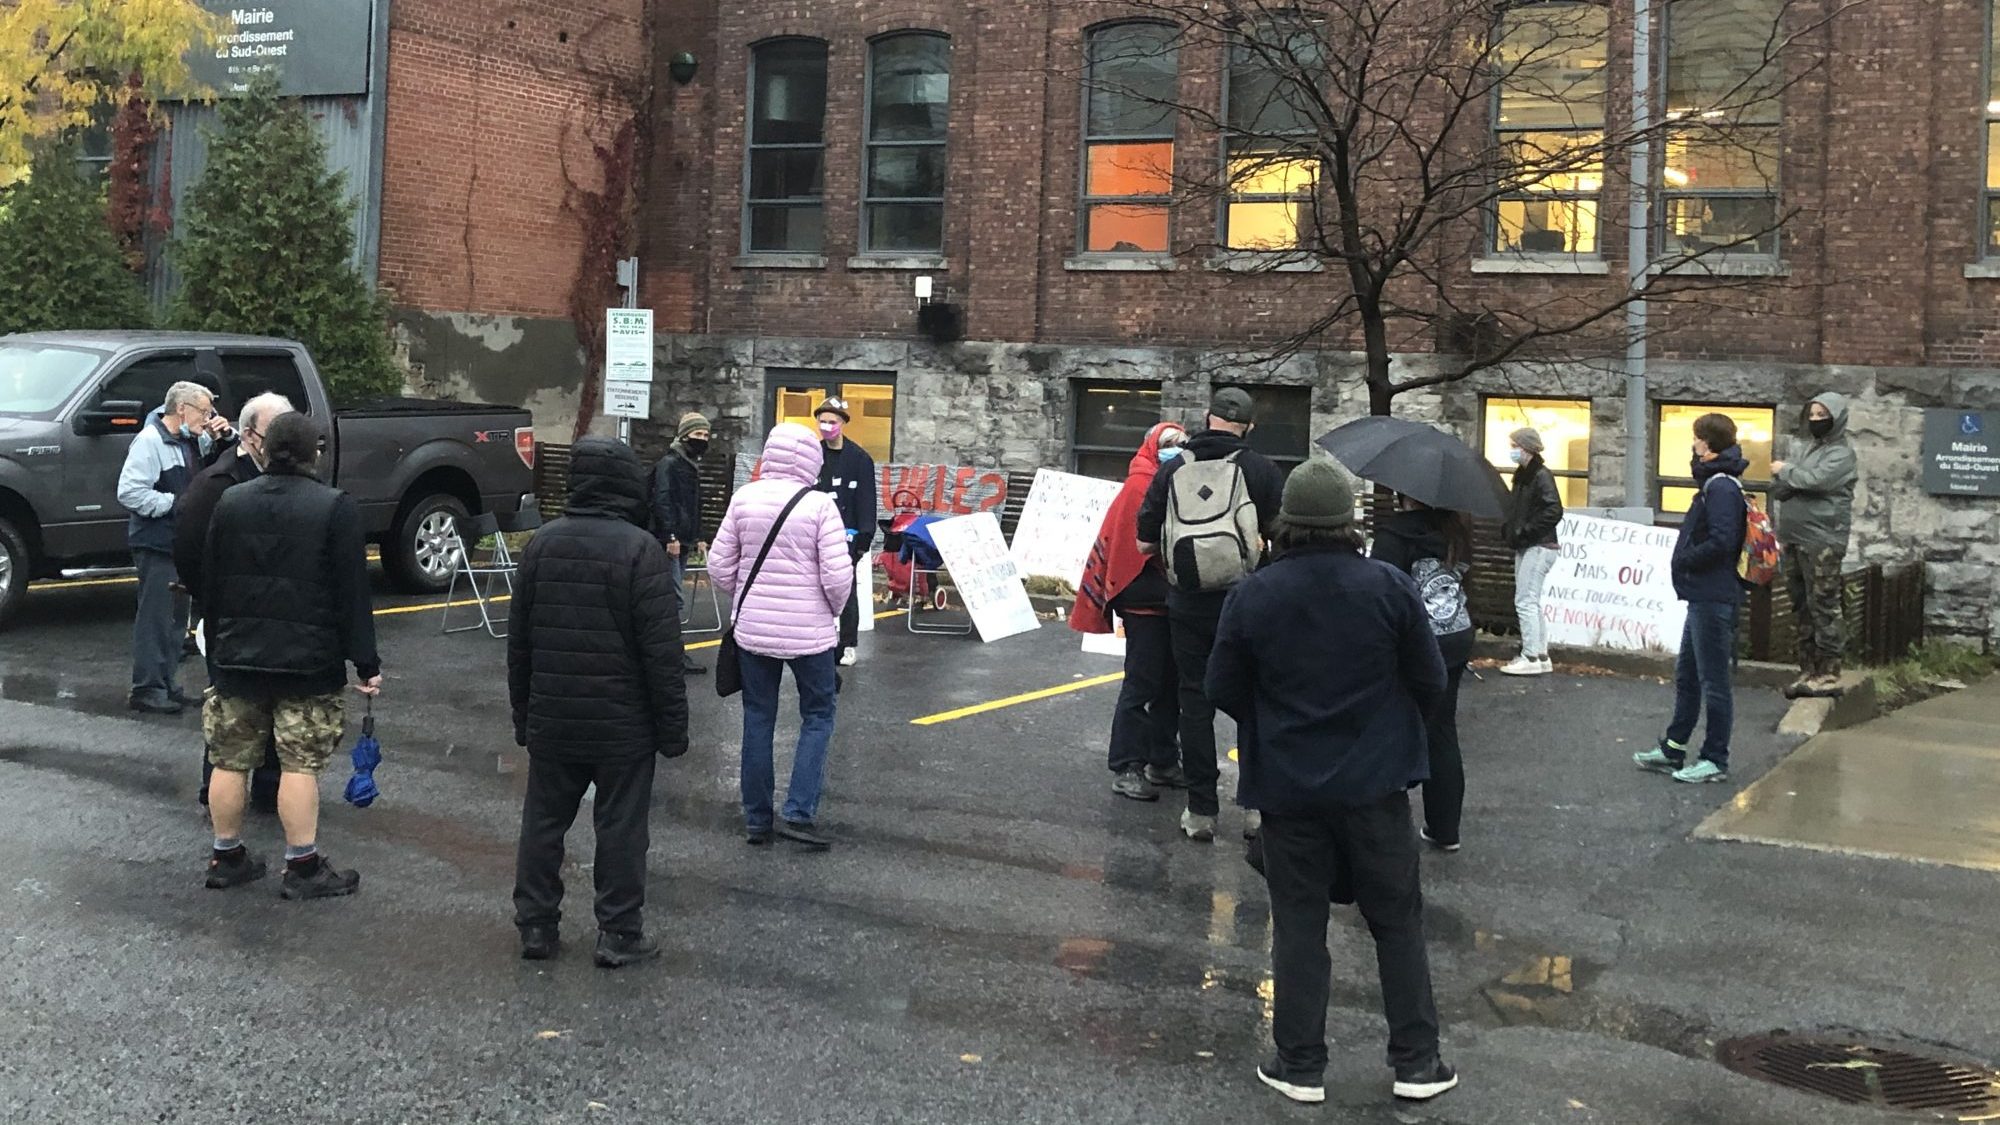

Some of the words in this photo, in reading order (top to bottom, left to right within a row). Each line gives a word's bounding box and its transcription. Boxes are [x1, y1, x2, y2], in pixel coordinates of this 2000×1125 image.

[231, 8, 274, 25] Mairie
[231, 44, 287, 58] Sud-Ouest
[474, 430, 510, 442] XTR
[1951, 442, 1988, 452] Mairie
[1935, 453, 2000, 464] Arrondissemen
[1953, 462, 1999, 472] Sud-Ouest
[1584, 522, 1638, 545] RESTE
[1645, 532, 1674, 548] CHE
[1573, 562, 1608, 580] MAIS
[1548, 585, 1579, 601] AVEC
[1585, 589, 1629, 607] TOUTES
[1636, 597, 1664, 612] CES
